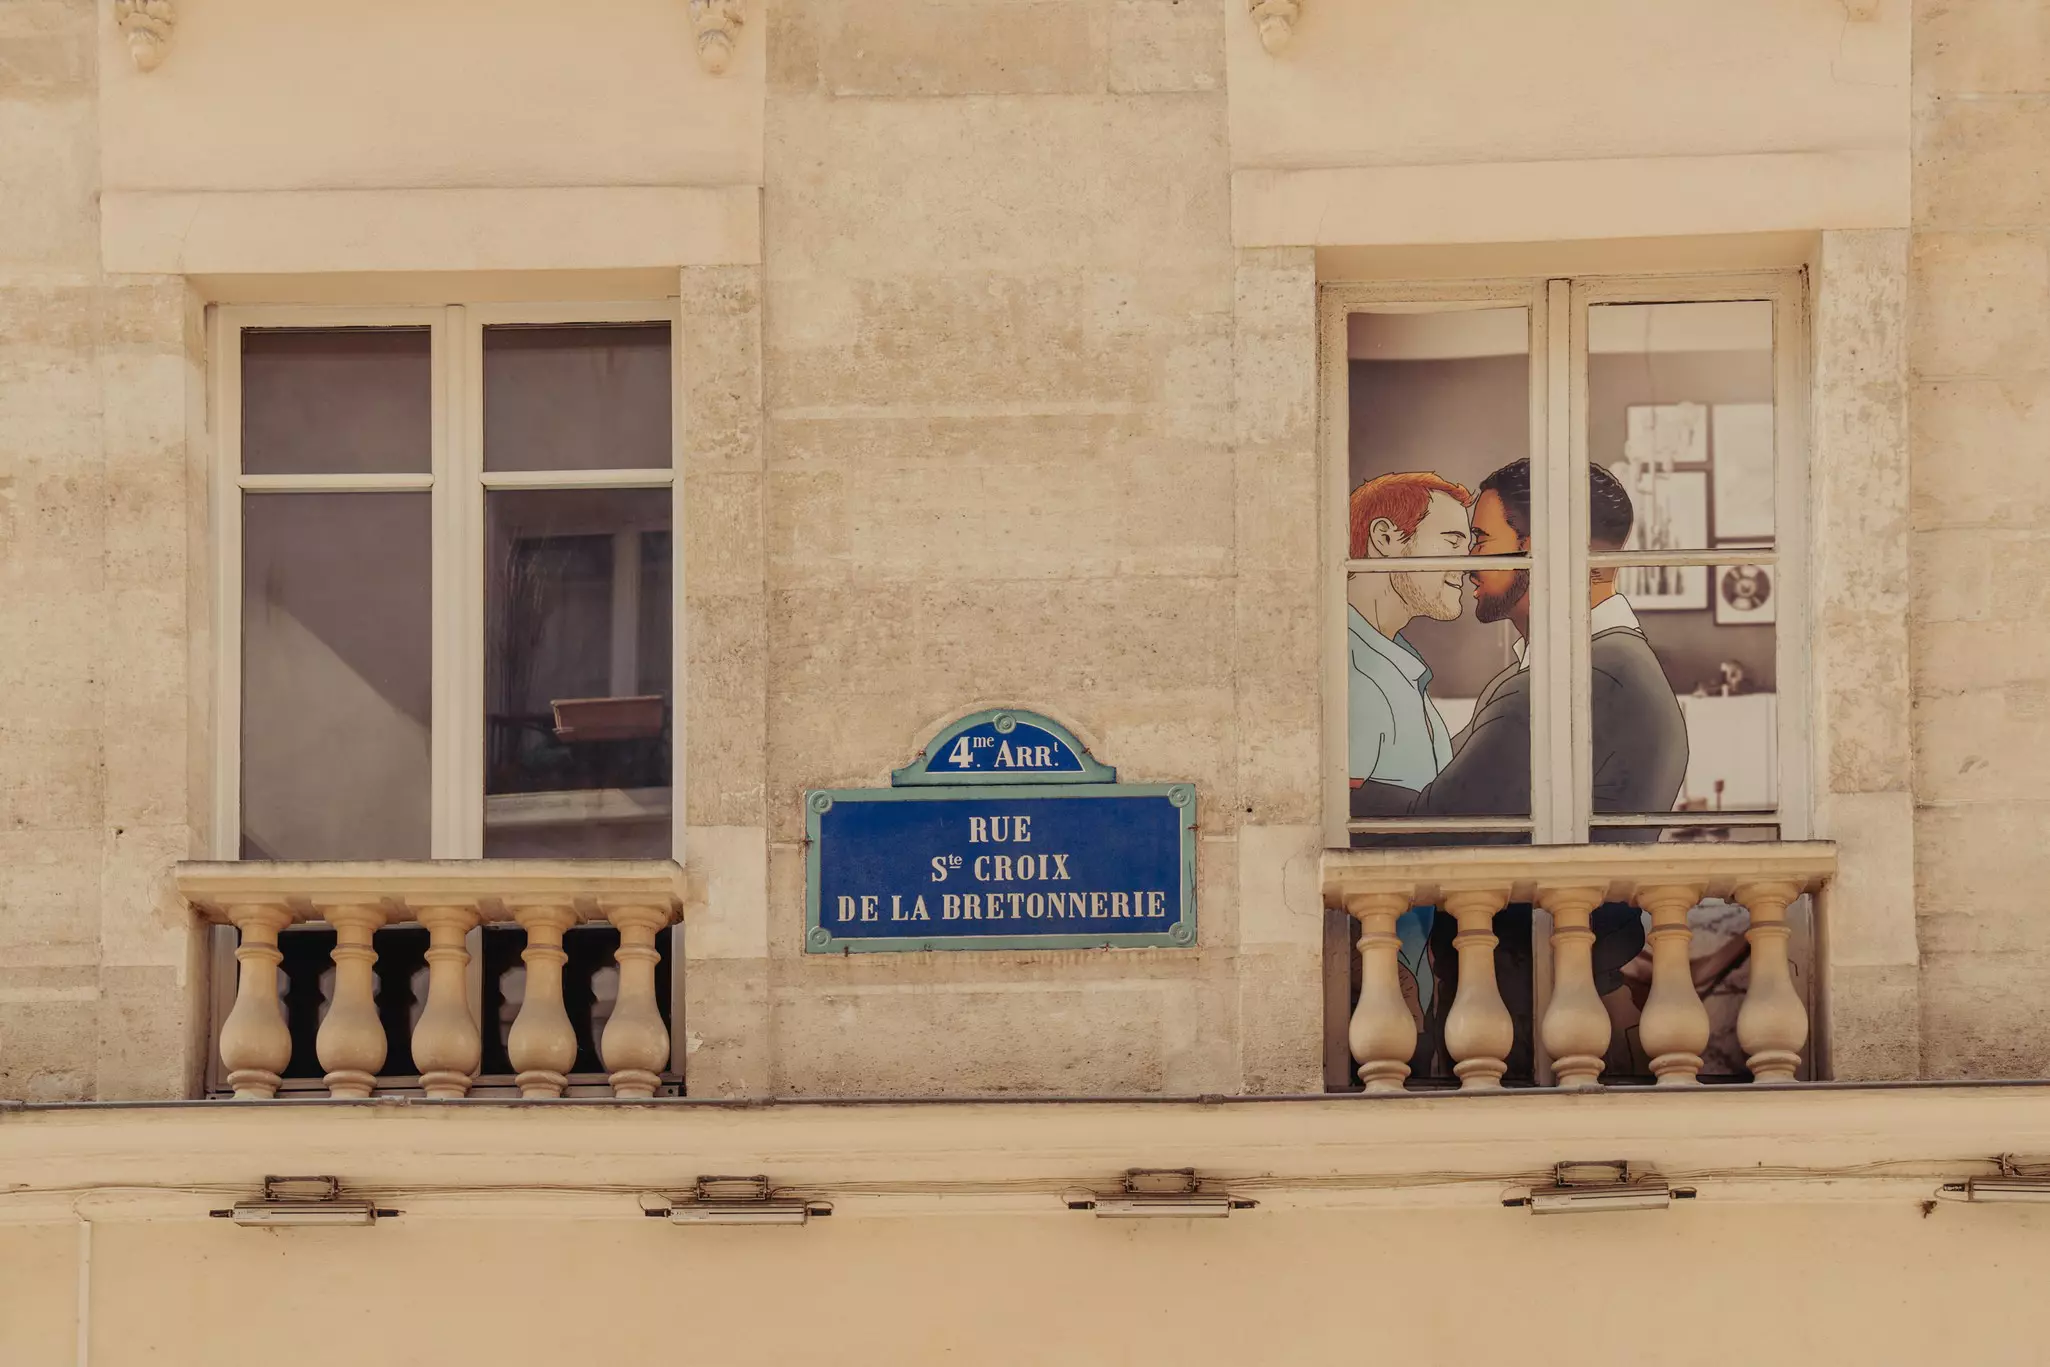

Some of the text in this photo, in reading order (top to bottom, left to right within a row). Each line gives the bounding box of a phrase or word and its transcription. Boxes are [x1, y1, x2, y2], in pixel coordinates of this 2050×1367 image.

[968, 815, 1032, 843] RUE
[931, 853, 1071, 882] Ste CROIX
[837, 891, 1166, 922] DE LA BRETONNERIE
